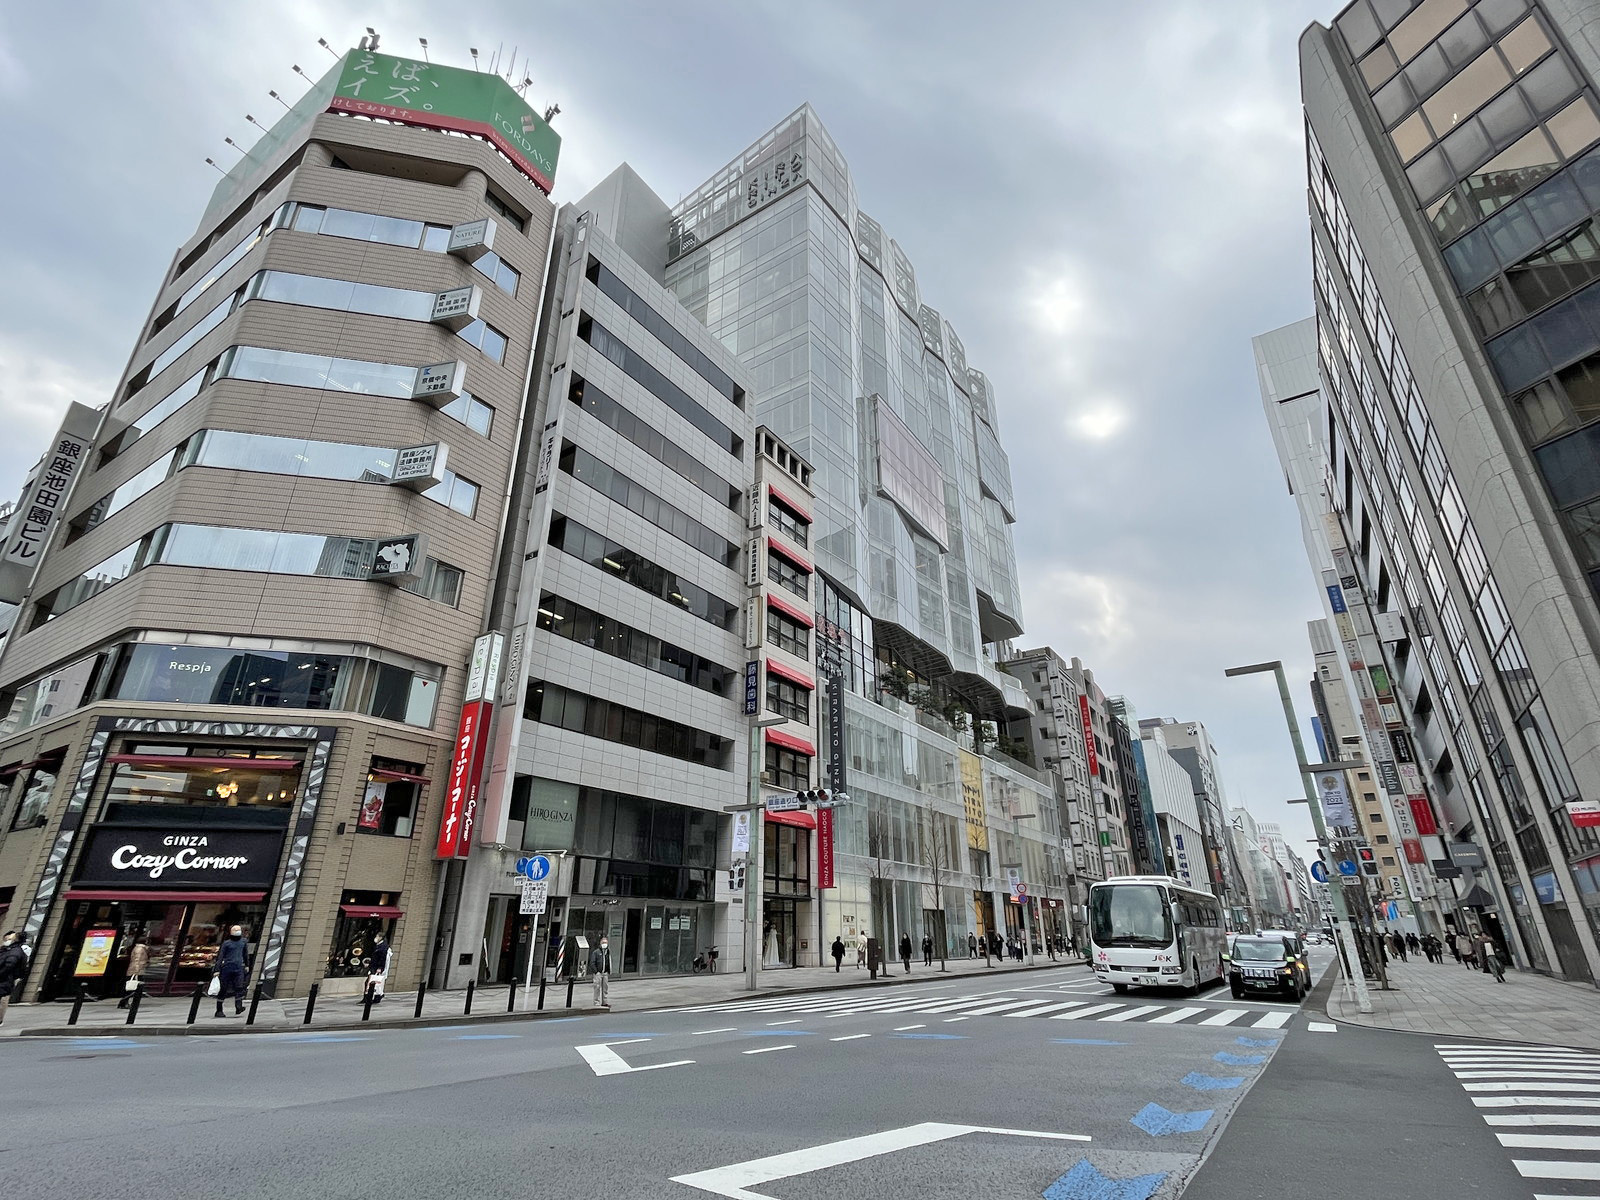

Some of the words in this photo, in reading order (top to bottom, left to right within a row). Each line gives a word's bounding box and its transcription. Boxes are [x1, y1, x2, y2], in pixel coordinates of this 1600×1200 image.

[495, 113, 552, 172] FORDAYS
[455, 230, 481, 239] NATURE
[10, 440, 82, 558] 銀座池田園ビル
[445, 735, 471, 843] コージーコーナー
[1382, 763, 1398, 790] Ishida
[163, 836, 208, 847] GINZA
[111, 845, 175, 878] Cozy
[175, 848, 248, 869] Corner
